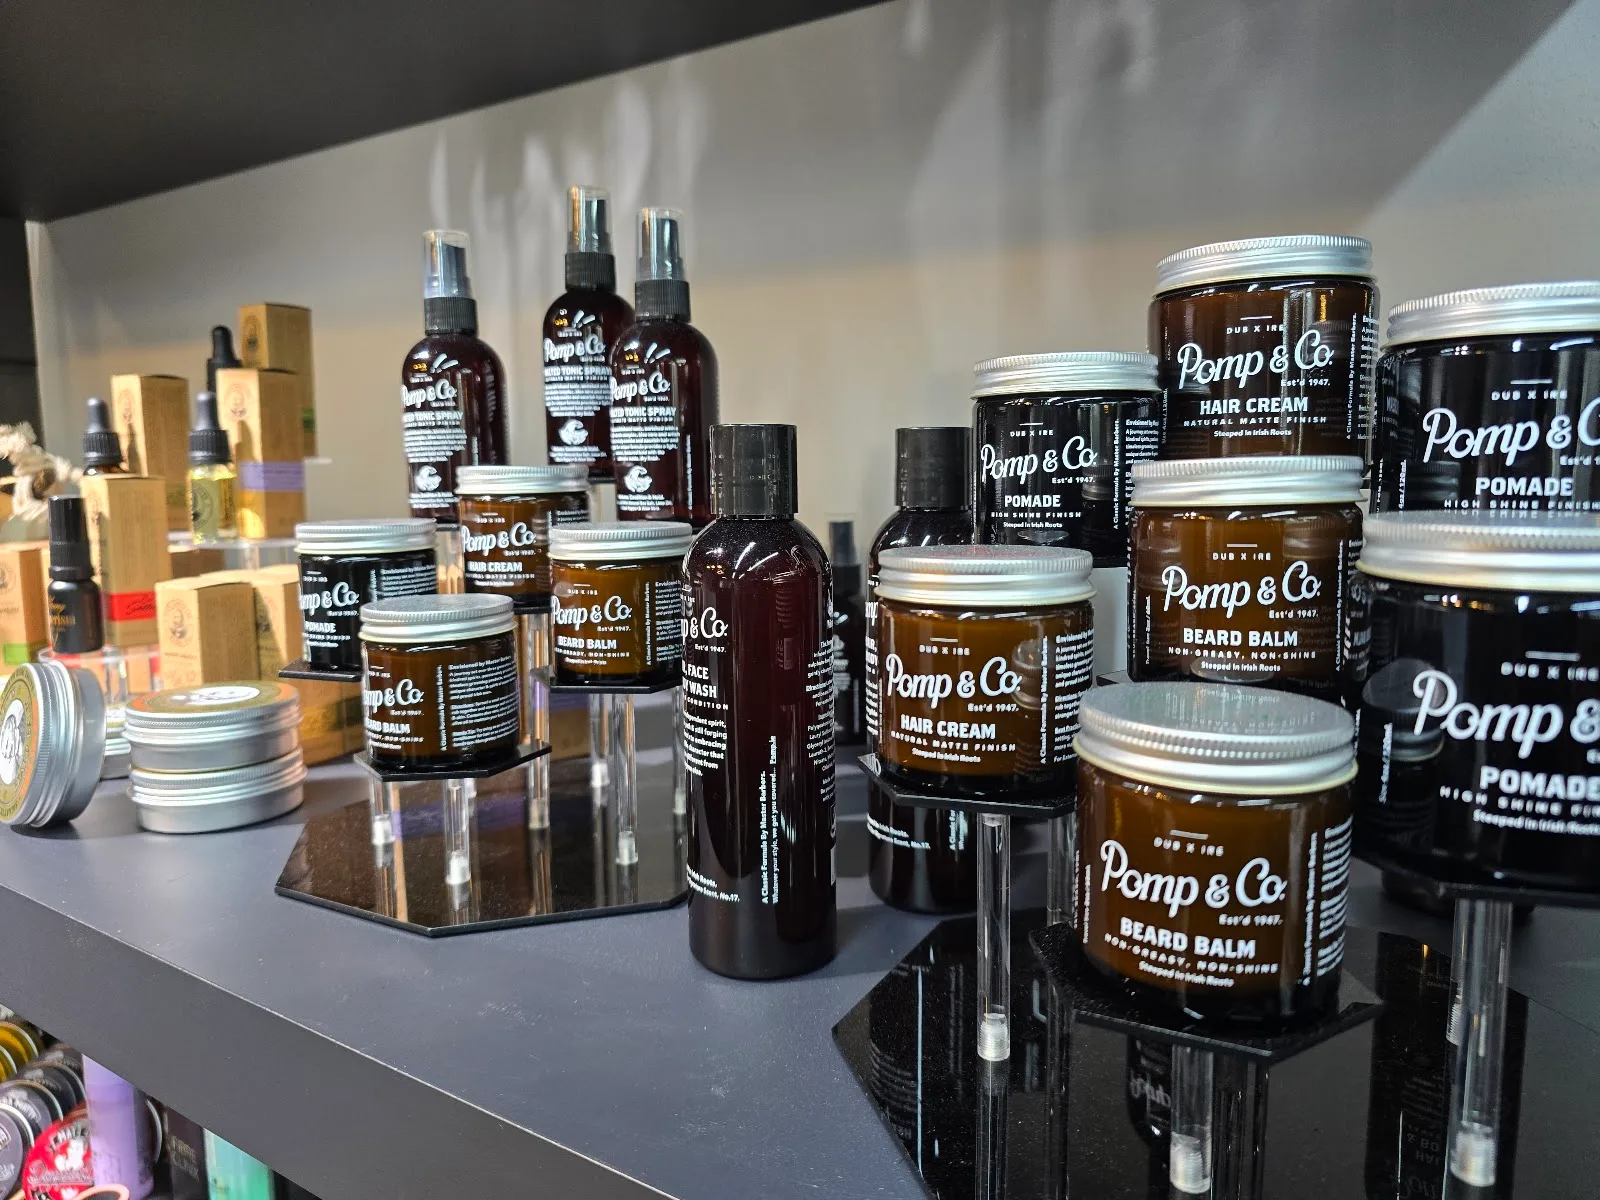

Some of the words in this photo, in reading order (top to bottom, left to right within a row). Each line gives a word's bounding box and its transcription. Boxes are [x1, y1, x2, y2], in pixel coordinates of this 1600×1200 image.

[1226, 325, 1249, 335] DUB
[1254, 325, 1261, 333] X
[1266, 324, 1285, 333] IRE
[1177, 342, 1264, 390] Pomp
[1269, 345, 1289, 374] &
[1294, 329, 1335, 370] Co.
[638, 378, 649, 396] &
[648, 369, 671, 394] Co.
[1280, 379, 1306, 387] Est'd
[1308, 378, 1331, 387] 1947.
[1348, 370, 1355, 379] By
[1491, 390, 1521, 401] DUB
[1527, 390, 1537, 399] X
[1543, 389, 1568, 400] IRE
[624, 406, 647, 417] TONIC
[646, 406, 677, 417] SPRAY
[1200, 398, 1241, 415] HAIR
[1245, 396, 1309, 413] CREAM
[1183, 419, 1234, 427] NATURAL
[1239, 416, 1279, 425] MATTE
[1286, 416, 1327, 424] FINISH
[1213, 430, 1244, 438] Steeped
[1422, 407, 1540, 467] Pomp
[1545, 414, 1573, 450] &
[980, 443, 1038, 485] Pomp
[1042, 449, 1058, 473] &
[1062, 435, 1099, 470] Co.
[1114, 467, 1120, 476] By
[1475, 476, 1574, 497] POMADE
[1004, 494, 1061, 508] POMADE
[1443, 499, 1481, 509] HIGH
[1489, 500, 1539, 510] SHINE
[1003, 521, 1024, 529] Steeped
[460, 524, 497, 557] Pomp
[497, 530, 510, 549] &
[509, 521, 537, 547] Co.
[1212, 552, 1235, 561] DUB
[1240, 552, 1247, 561] X
[1253, 552, 1272, 561] IRE
[467, 561, 487, 573] HAIR
[487, 561, 523, 573] CREAM
[320, 590, 333, 609] &
[332, 581, 360, 608] Co.
[1161, 565, 1251, 618] Pomp
[1256, 576, 1277, 606] &
[1281, 560, 1322, 603] Co.
[550, 595, 588, 631] Pomp
[589, 604, 603, 624] &
[603, 595, 633, 622] Co.
[1268, 609, 1294, 619] Est'd
[1297, 609, 1319, 619] 1947.
[304, 620, 337, 634] POMADE
[690, 617, 699, 639] &
[700, 606, 729, 639] Co.
[557, 635, 585, 649] BEARD
[586, 638, 617, 650] BALM
[1183, 627, 1242, 646] BEARD
[1248, 630, 1298, 647] BALM
[919, 644, 939, 654] DUB
[687, 663, 709, 680] FACE
[1201, 661, 1231, 672] Steeped
[1241, 661, 1258, 671] Irish
[1259, 662, 1281, 672] Roots
[689, 680, 718, 699] WASH
[885, 653, 953, 709] Pomp
[956, 671, 976, 699] &
[979, 656, 1023, 697] Co.
[383, 687, 396, 707] &
[395, 678, 425, 706] Co.
[1412, 669, 1565, 760] Pomp
[1569, 698, 1600, 745] &
[382, 722, 411, 735] BALM
[703, 727, 728, 740] forging
[900, 714, 933, 735] HAIR
[936, 720, 996, 740] CREAM
[891, 730, 928, 746] NATURAL
[932, 740, 969, 751] MATTE
[974, 743, 1016, 752] FINISH
[1479, 765, 1600, 802] POMADE
[761, 830, 769, 840] By
[1100, 839, 1200, 918] Pomp
[1204, 874, 1231, 909] &
[1235, 857, 1289, 908] Co.
[1120, 916, 1188, 952] BEARD
[1193, 935, 1257, 960] BALM
